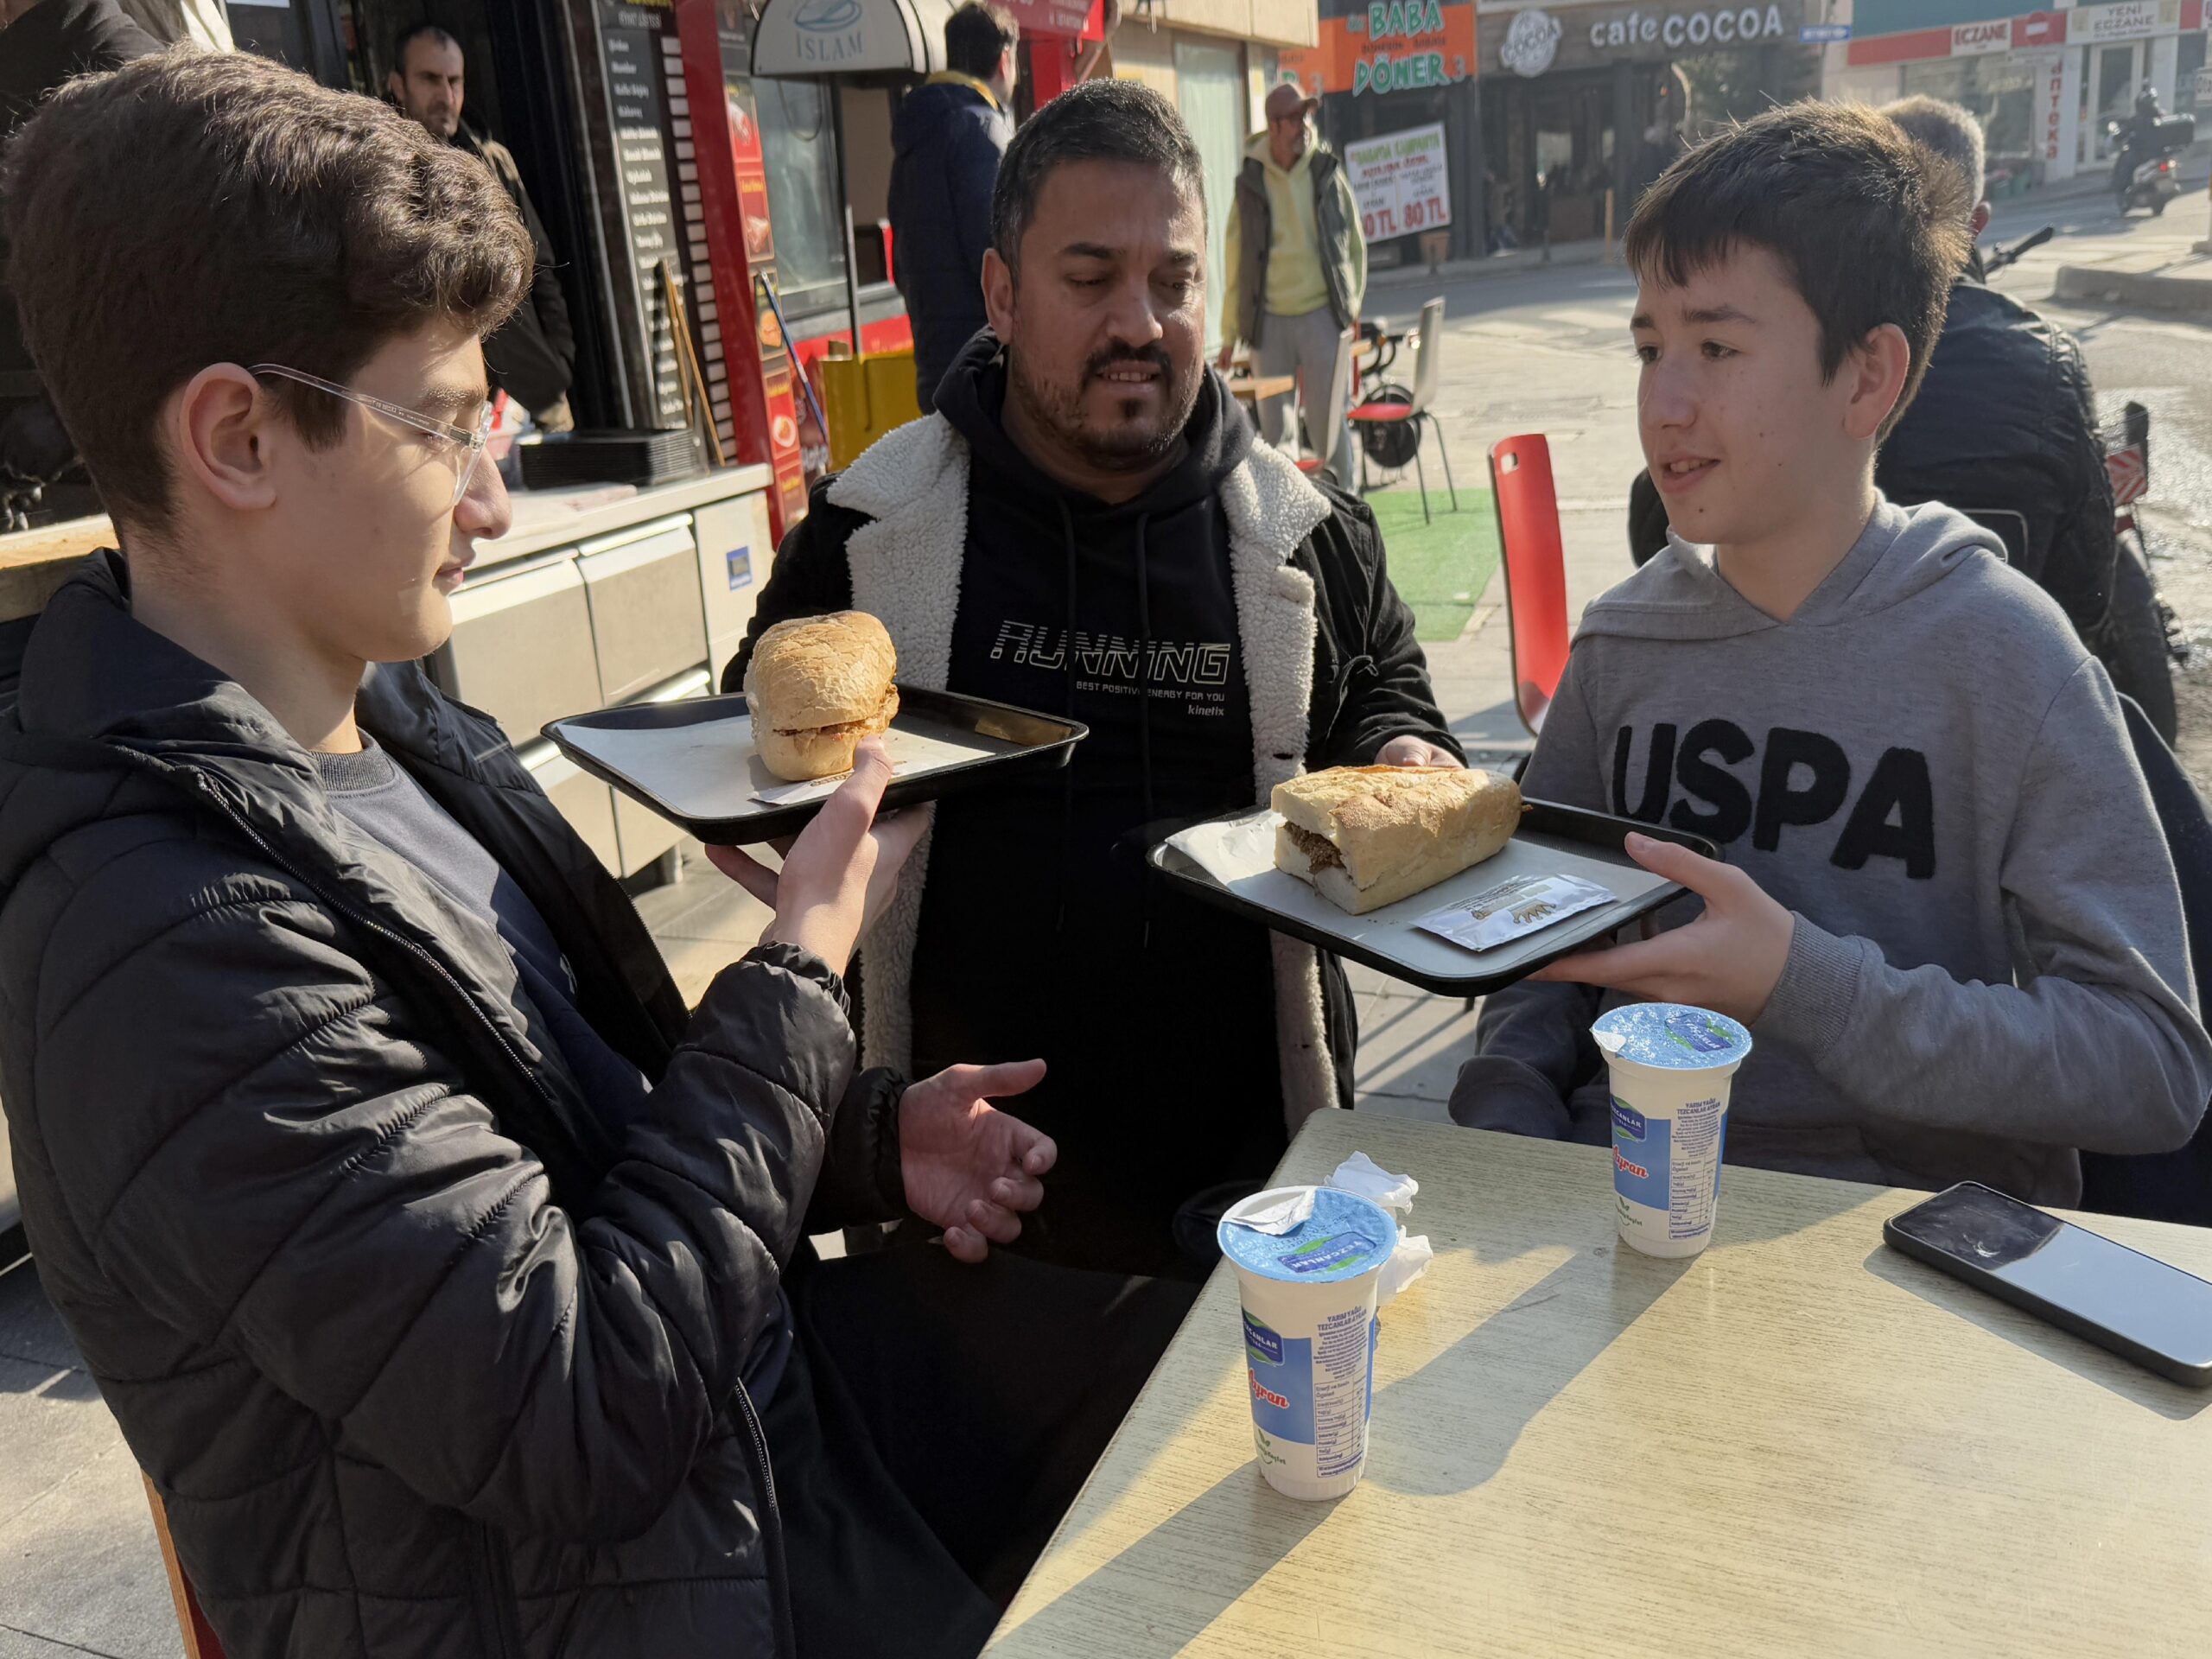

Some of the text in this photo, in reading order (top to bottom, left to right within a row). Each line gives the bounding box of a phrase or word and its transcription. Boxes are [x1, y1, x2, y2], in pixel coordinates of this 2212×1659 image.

[1369, 0, 1446, 41] BABA
[1590, 11, 1658, 47] cafe
[1662, 3, 1784, 47] COCOA
[1954, 22, 2008, 47] ECZANE
[2094, 15, 2155, 31] ECZANE
[1352, 53, 1452, 98] DÖNER
[1361, 207, 1396, 238] 0 TL
[1405, 195, 1446, 230] 80 TL
[990, 620, 1231, 685] RUNNING
[1076, 680, 1099, 692] BEST
[1103, 684, 1141, 696] POSITIV
[1185, 691, 1204, 702] FOR
[1206, 693, 1225, 702] YOU
[1187, 704, 1225, 717] kinetix
[1612, 718, 1936, 880] USPA
[1292, 1240, 1363, 1269] TEZCANLAR
